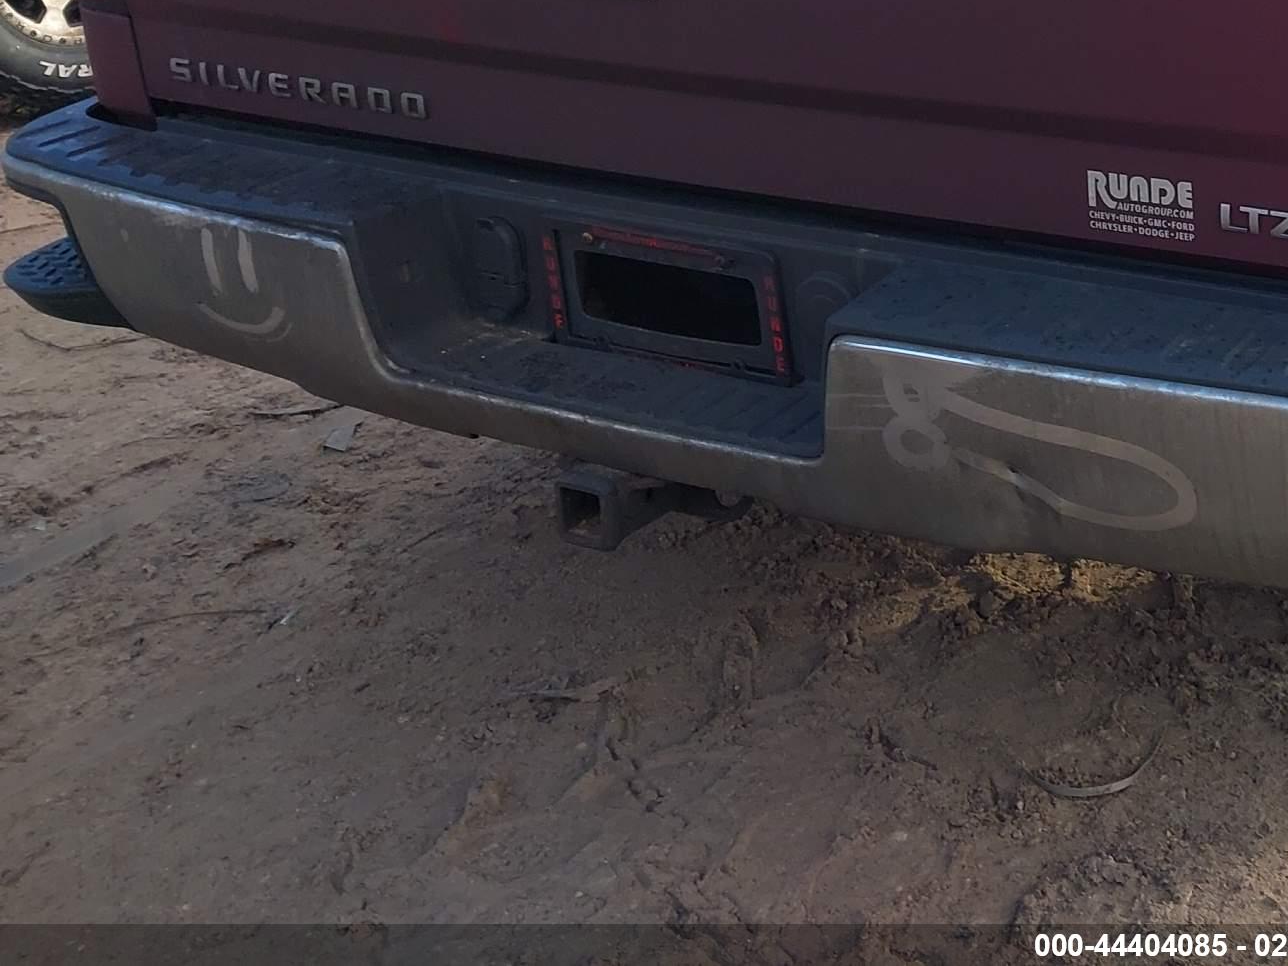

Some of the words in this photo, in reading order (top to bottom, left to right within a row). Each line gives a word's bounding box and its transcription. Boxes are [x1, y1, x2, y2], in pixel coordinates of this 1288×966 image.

[169, 57, 427, 120] SILVERADO
[1087, 170, 1193, 209] RUNDE
[1117, 202, 1194, 220] AUTOGROUP.COM
